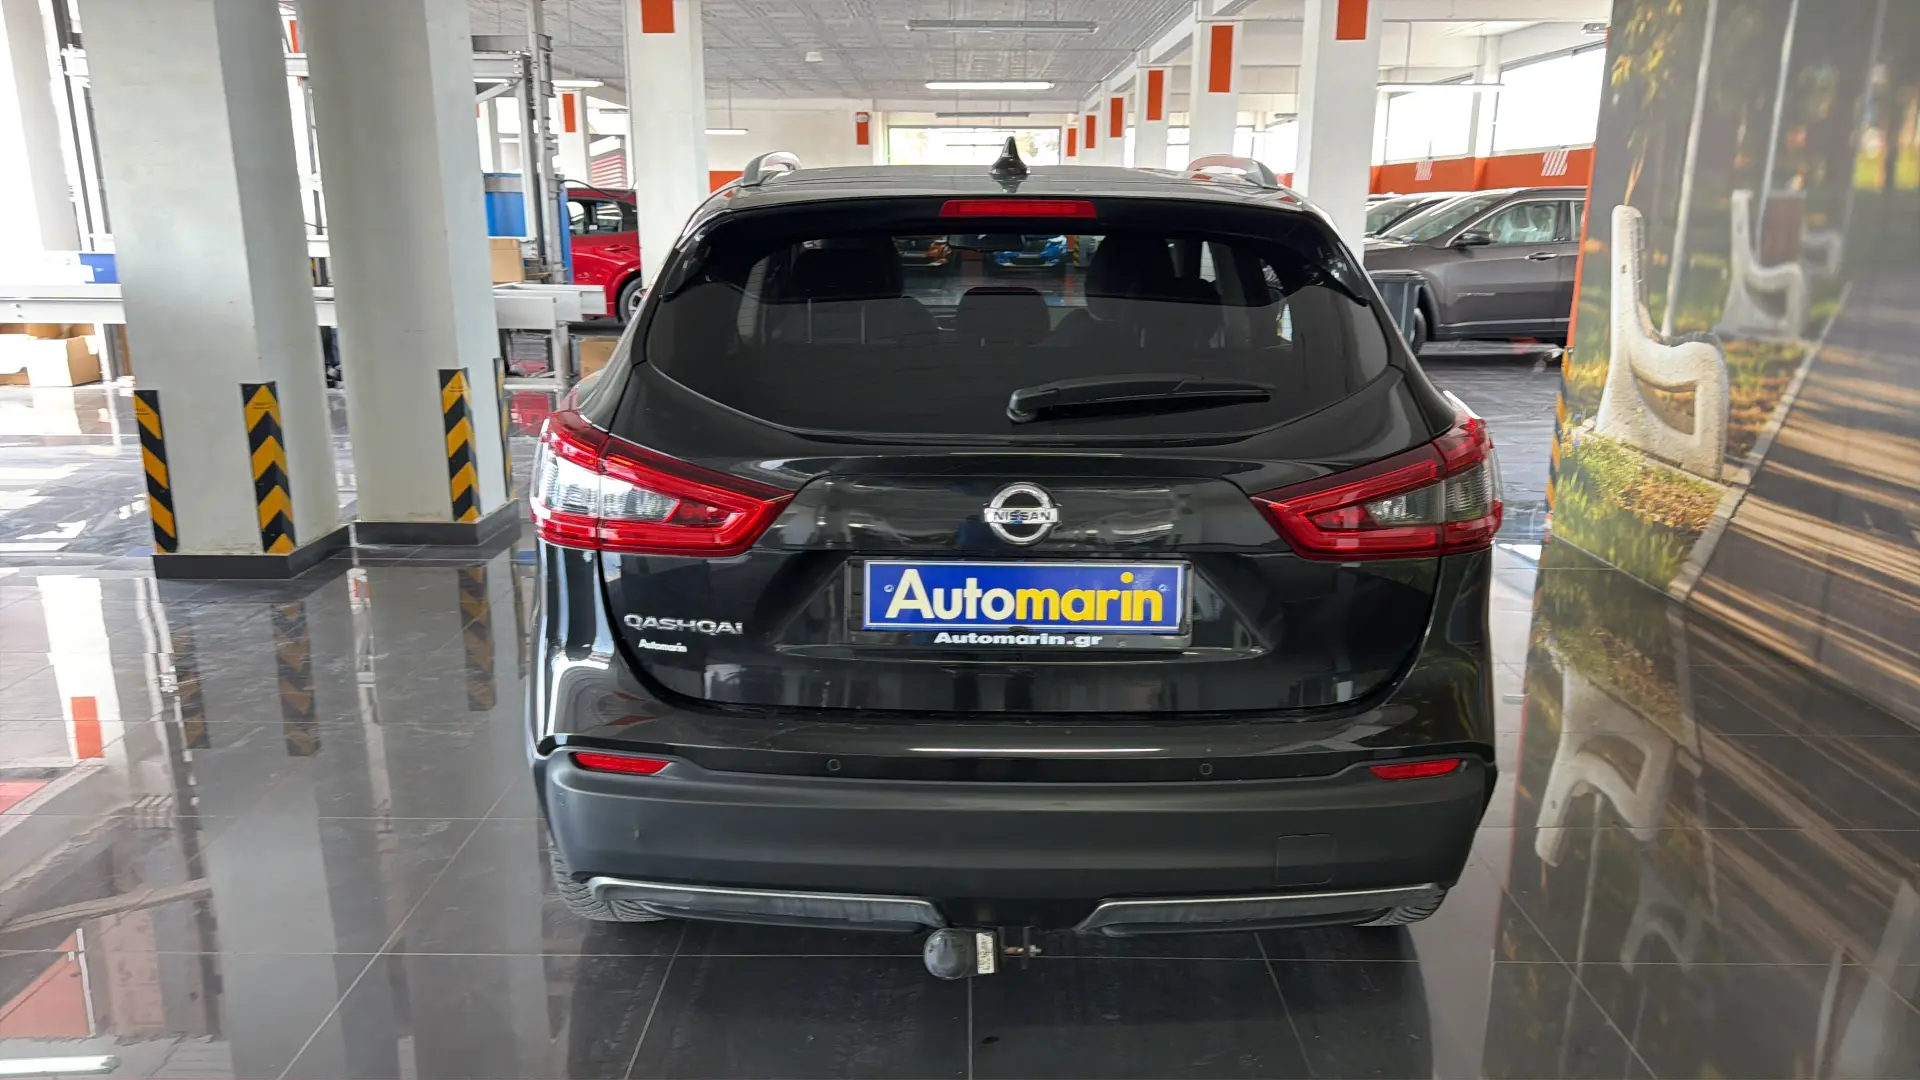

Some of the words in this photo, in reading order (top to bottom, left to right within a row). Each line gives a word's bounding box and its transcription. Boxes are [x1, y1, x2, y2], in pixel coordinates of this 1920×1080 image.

[993, 511, 1051, 521] NISSAN
[884, 568, 1164, 622] Automarin
[623, 613, 744, 636] QASHQAI
[933, 631, 1103, 648] Automarin.gr
